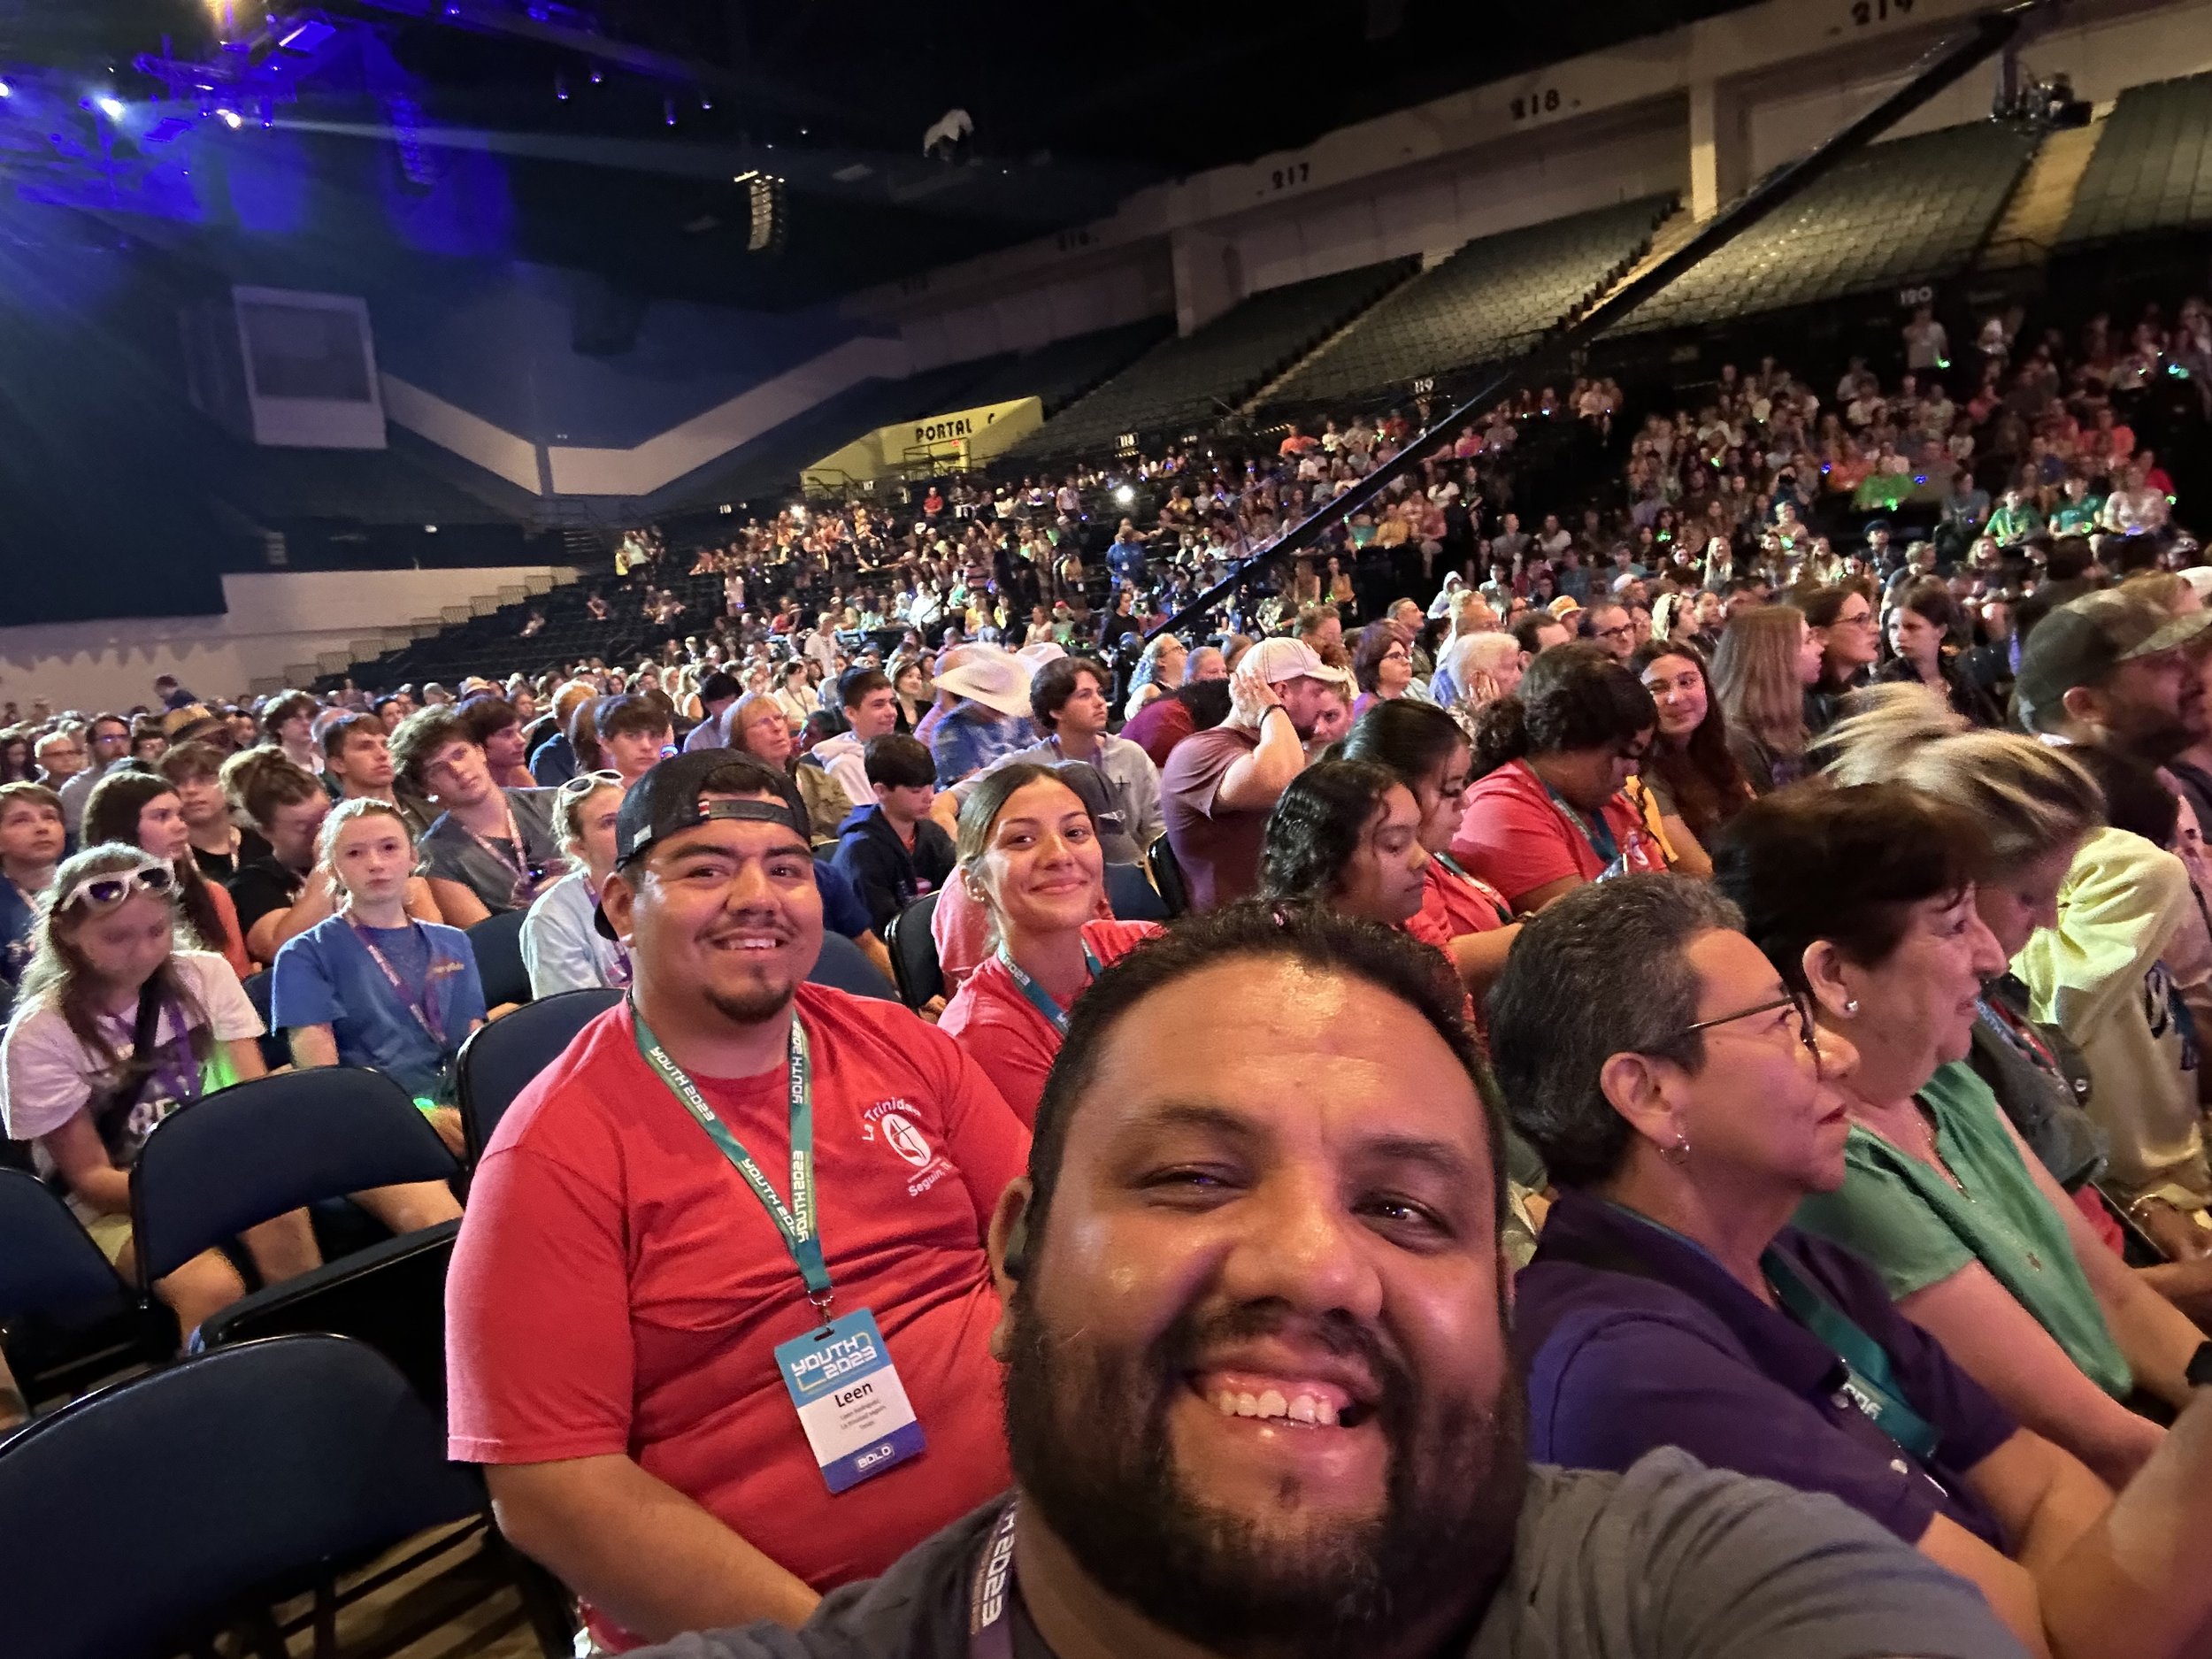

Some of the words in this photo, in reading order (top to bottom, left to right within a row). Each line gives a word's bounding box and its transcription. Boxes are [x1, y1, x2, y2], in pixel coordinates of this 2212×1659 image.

[1510, 89, 1559, 120] 218
[1272, 163, 1309, 189] 217
[916, 418, 972, 442] PORTAL
[650, 1046, 689, 1087] YOUTH
[683, 1083, 715, 1121] 2023
[791, 1056, 803, 1104] YOUTH
[861, 1123, 874, 1141] La
[741, 1157, 780, 1204] YOUTH
[792, 1150, 805, 1190] 2023
[908, 1169, 947, 1196] Seguin,
[794, 1190, 809, 1243] YOUTH
[791, 1336, 858, 1377] YOUTH
[822, 1345, 878, 1380] 2023
[834, 1382, 873, 1409] Leen
[858, 1446, 893, 1469] BOLD
[982, 1533, 1015, 1628] 2023
